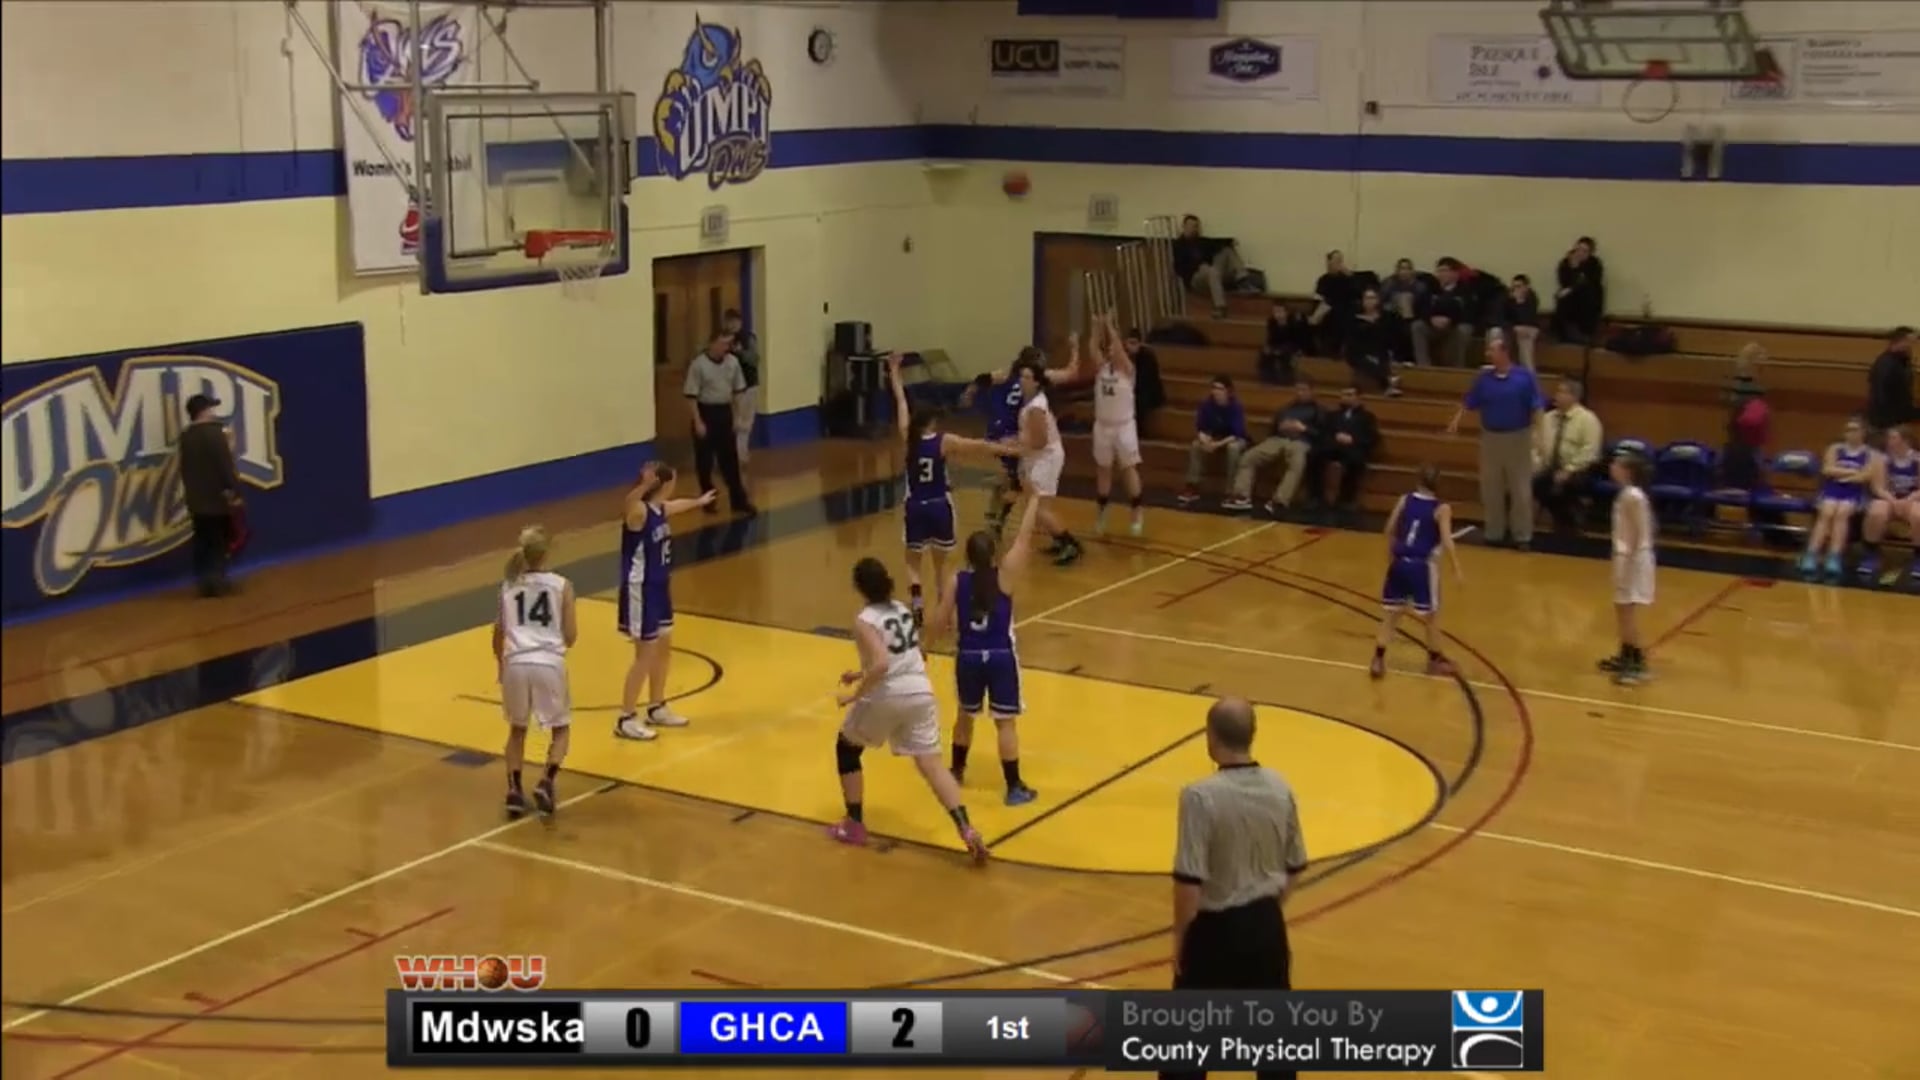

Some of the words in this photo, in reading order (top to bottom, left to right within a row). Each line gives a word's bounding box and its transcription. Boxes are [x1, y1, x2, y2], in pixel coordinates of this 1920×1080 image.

[994, 42, 1057, 69] UCU
[919, 457, 933, 482] 3
[514, 591, 552, 627] 14
